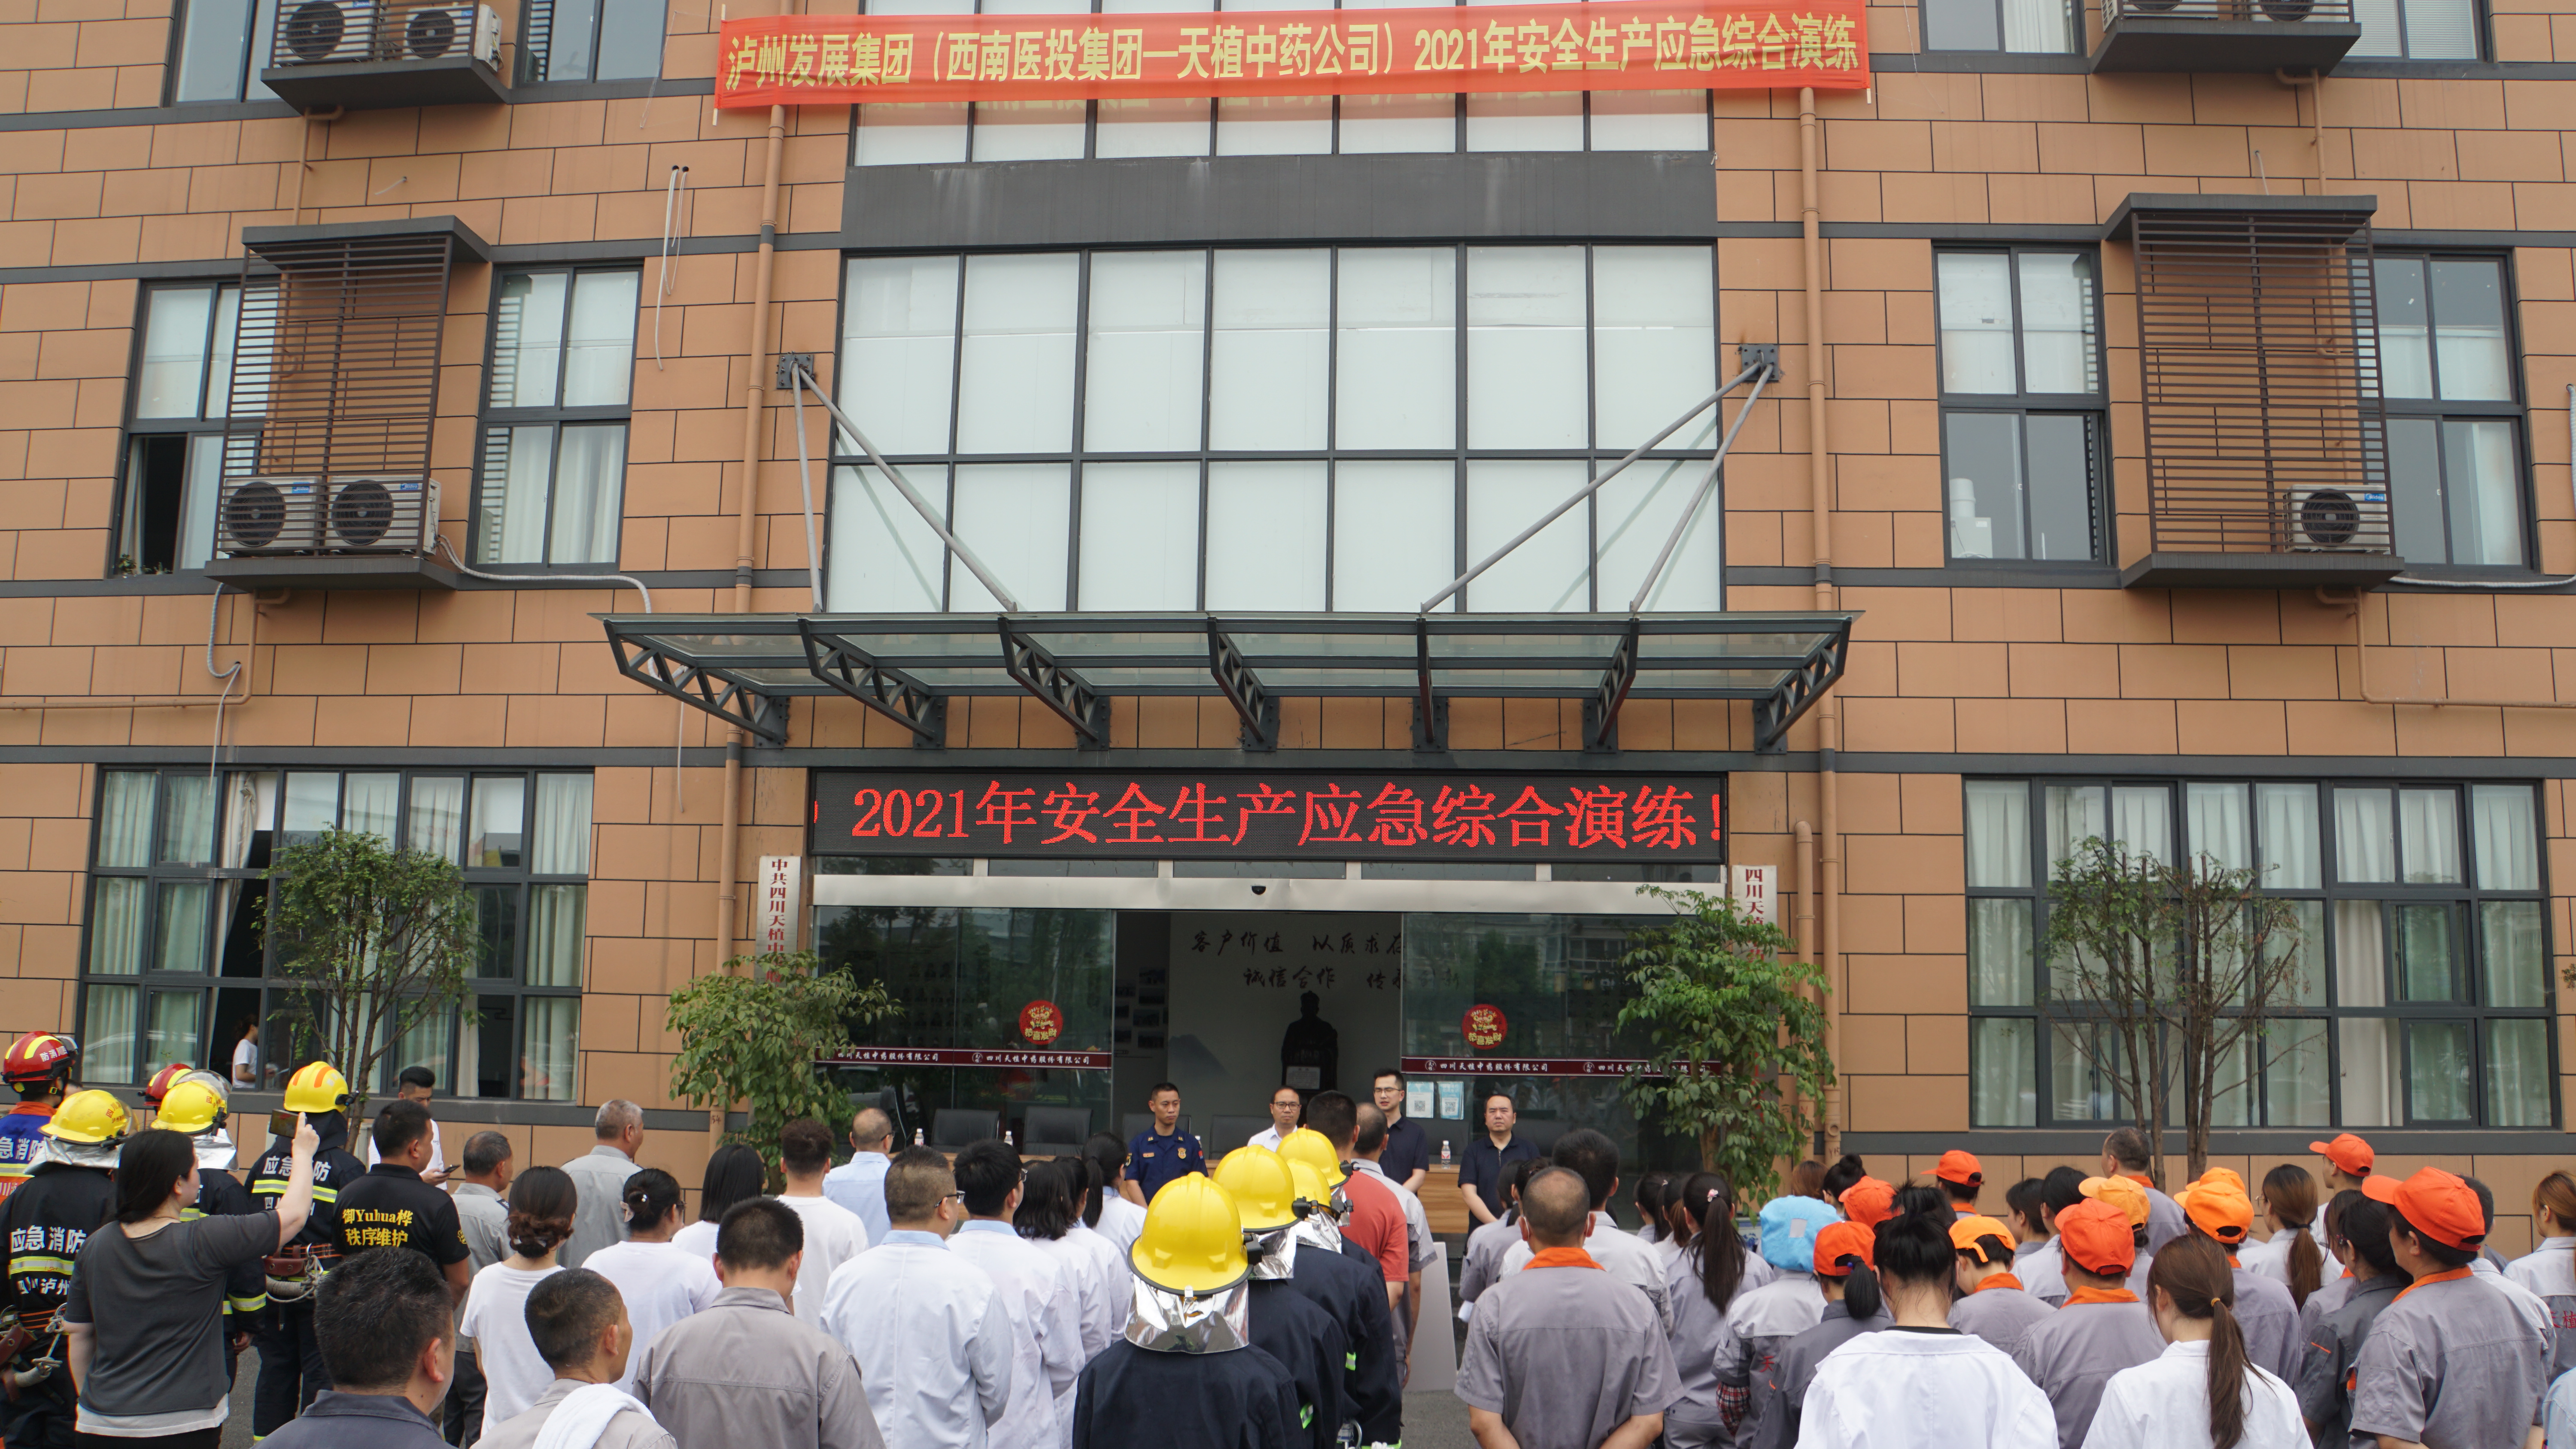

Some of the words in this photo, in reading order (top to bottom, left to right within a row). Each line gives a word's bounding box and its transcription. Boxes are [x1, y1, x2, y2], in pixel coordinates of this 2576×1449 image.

[1025, 1028, 1057, 1041] 恭喜发财
[1468, 1032, 1502, 1045] 恭喜发财
[986, 1054, 1089, 1064] 四川天植中药股份有限公司
[1440, 1062, 1548, 1072] 四川天植中药股份有限公司
[263, 1155, 331, 1181] 应急防
[11, 1225, 87, 1254] 应急消防
[345, 1227, 408, 1248] 秩序维护
